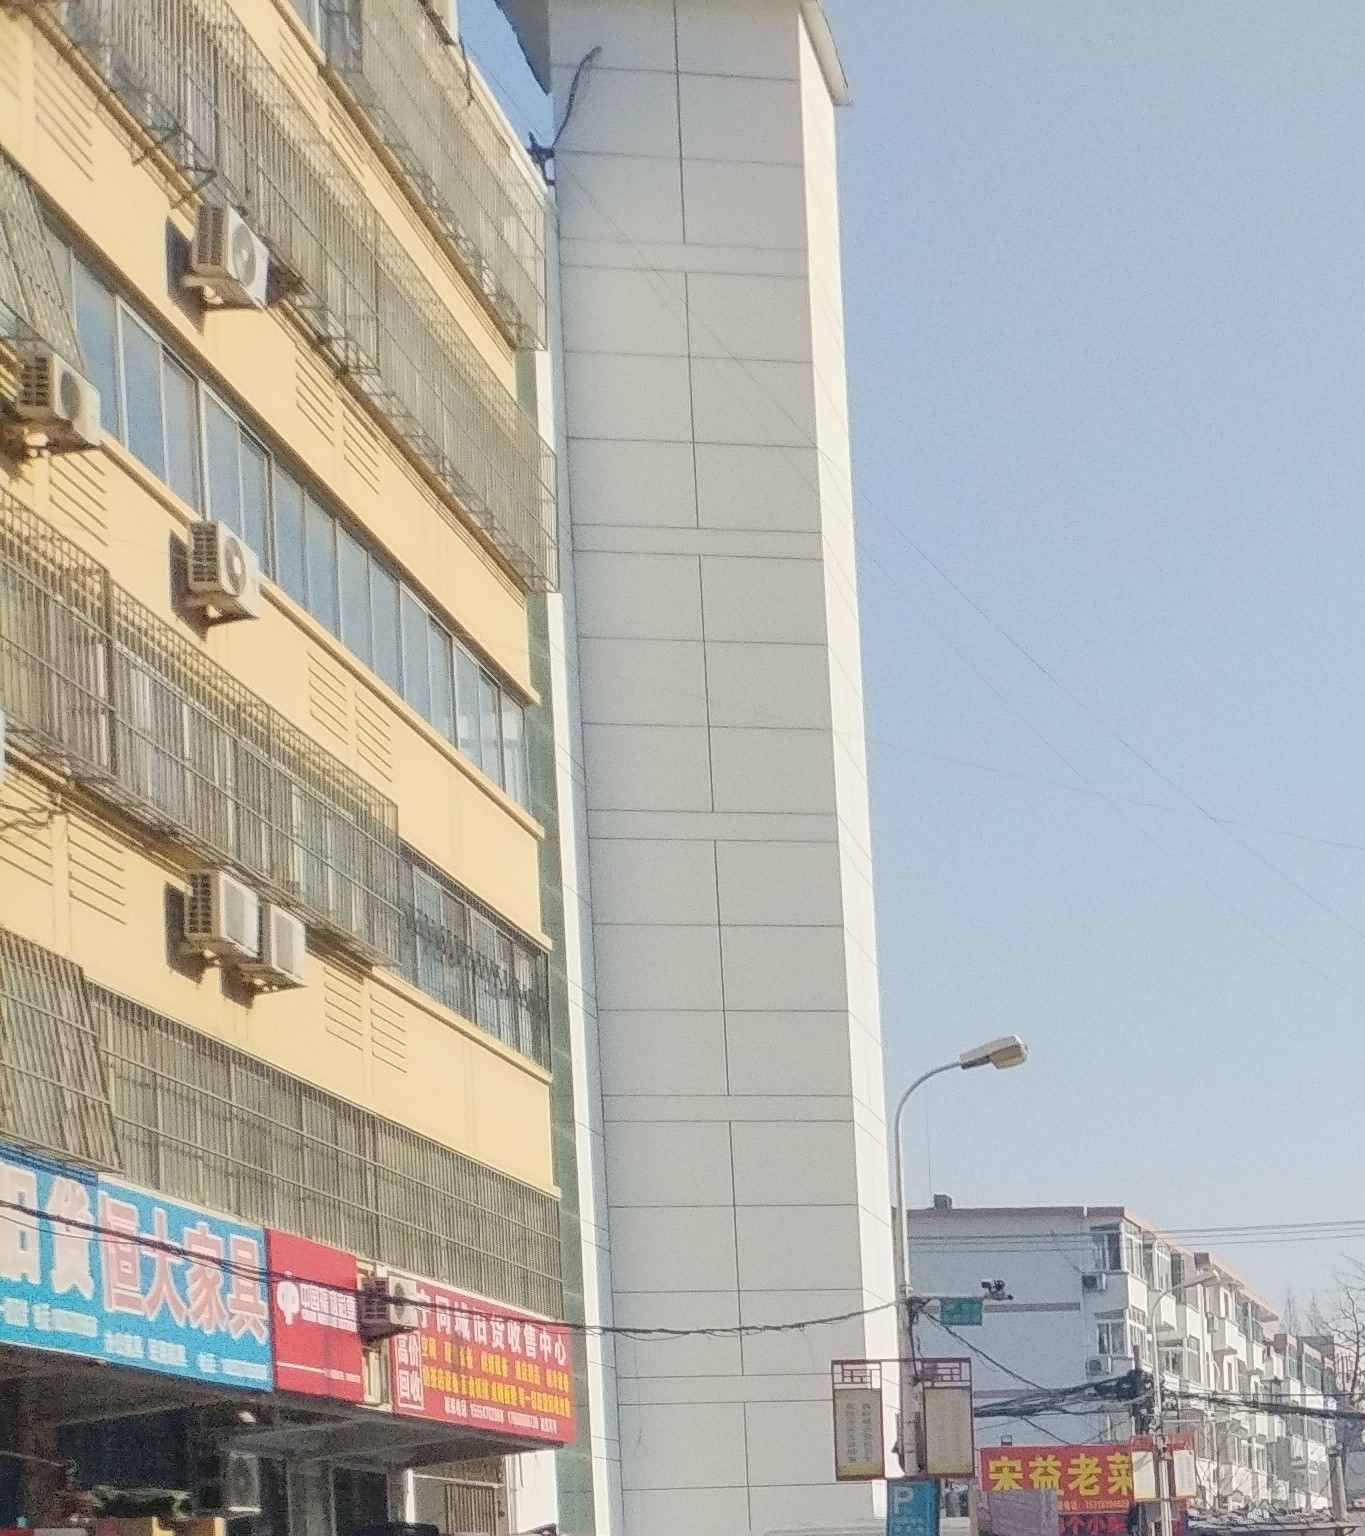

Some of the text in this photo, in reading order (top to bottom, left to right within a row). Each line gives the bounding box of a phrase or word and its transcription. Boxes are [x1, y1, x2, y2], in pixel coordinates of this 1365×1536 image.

[98, 1190, 268, 1345] 恒大家具
[398, 1368, 422, 1402] 回收
